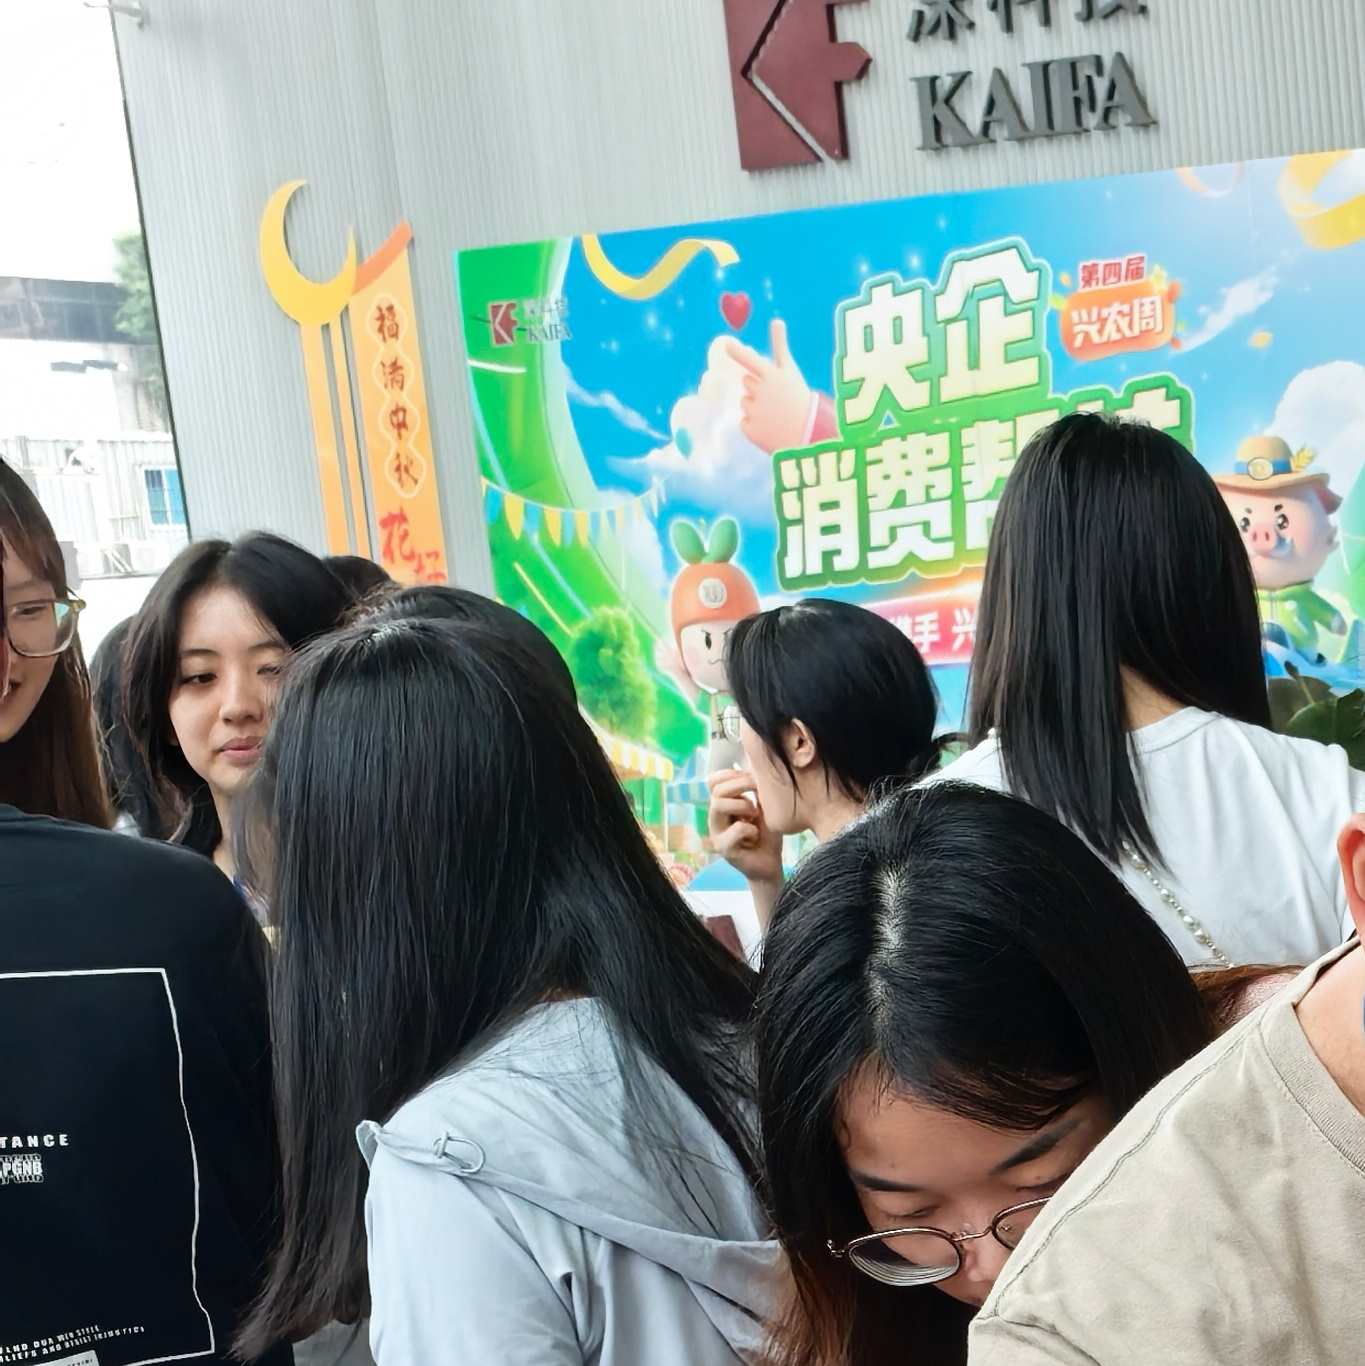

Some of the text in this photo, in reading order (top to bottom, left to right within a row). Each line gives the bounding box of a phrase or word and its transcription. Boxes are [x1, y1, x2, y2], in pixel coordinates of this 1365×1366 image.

[909, 51, 1158, 151] KAIFA
[1079, 255, 1147, 290] 第四届
[528, 323, 574, 343] KAIFA
[843, 247, 1041, 425] 央企
[1071, 294, 1165, 349] 兴农周
[374, 304, 418, 487] 福满中秋
